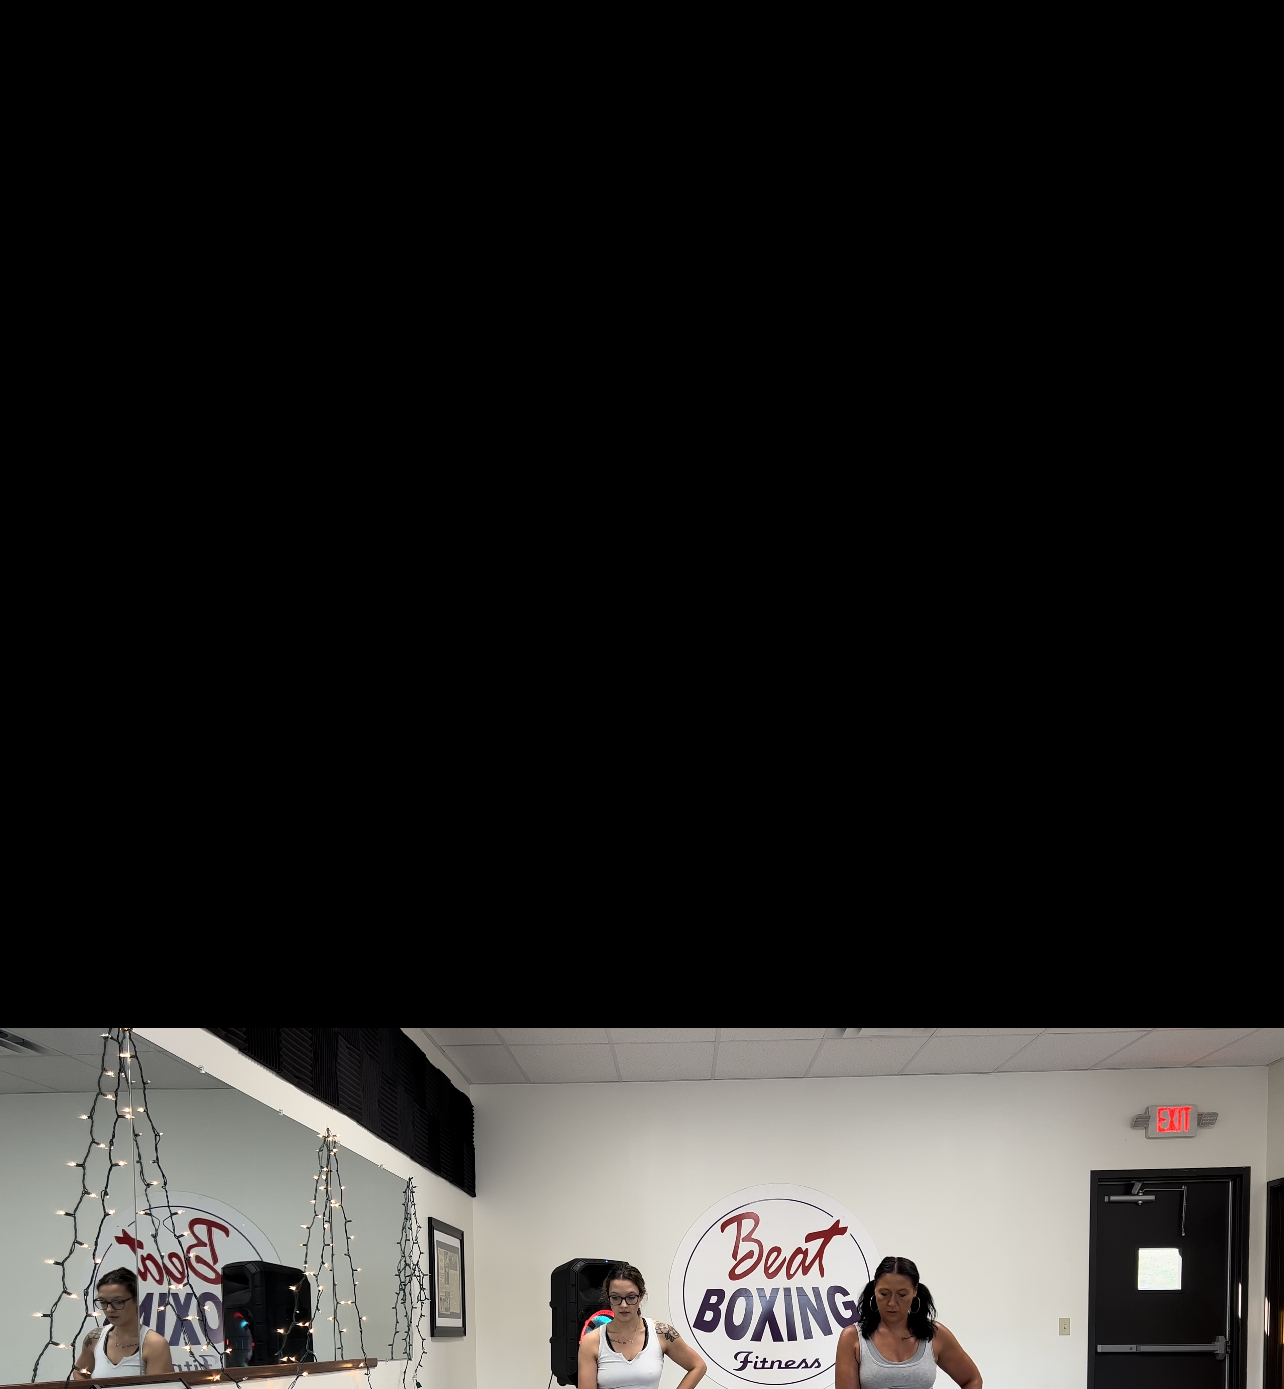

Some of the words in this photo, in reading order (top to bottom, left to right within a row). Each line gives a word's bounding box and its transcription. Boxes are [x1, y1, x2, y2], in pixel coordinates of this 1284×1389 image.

[1157, 1106, 1192, 1132] EXIT
[720, 1211, 849, 1281] Beat
[693, 1285, 861, 1342] BOXING
[733, 1351, 822, 1371] Fitness
